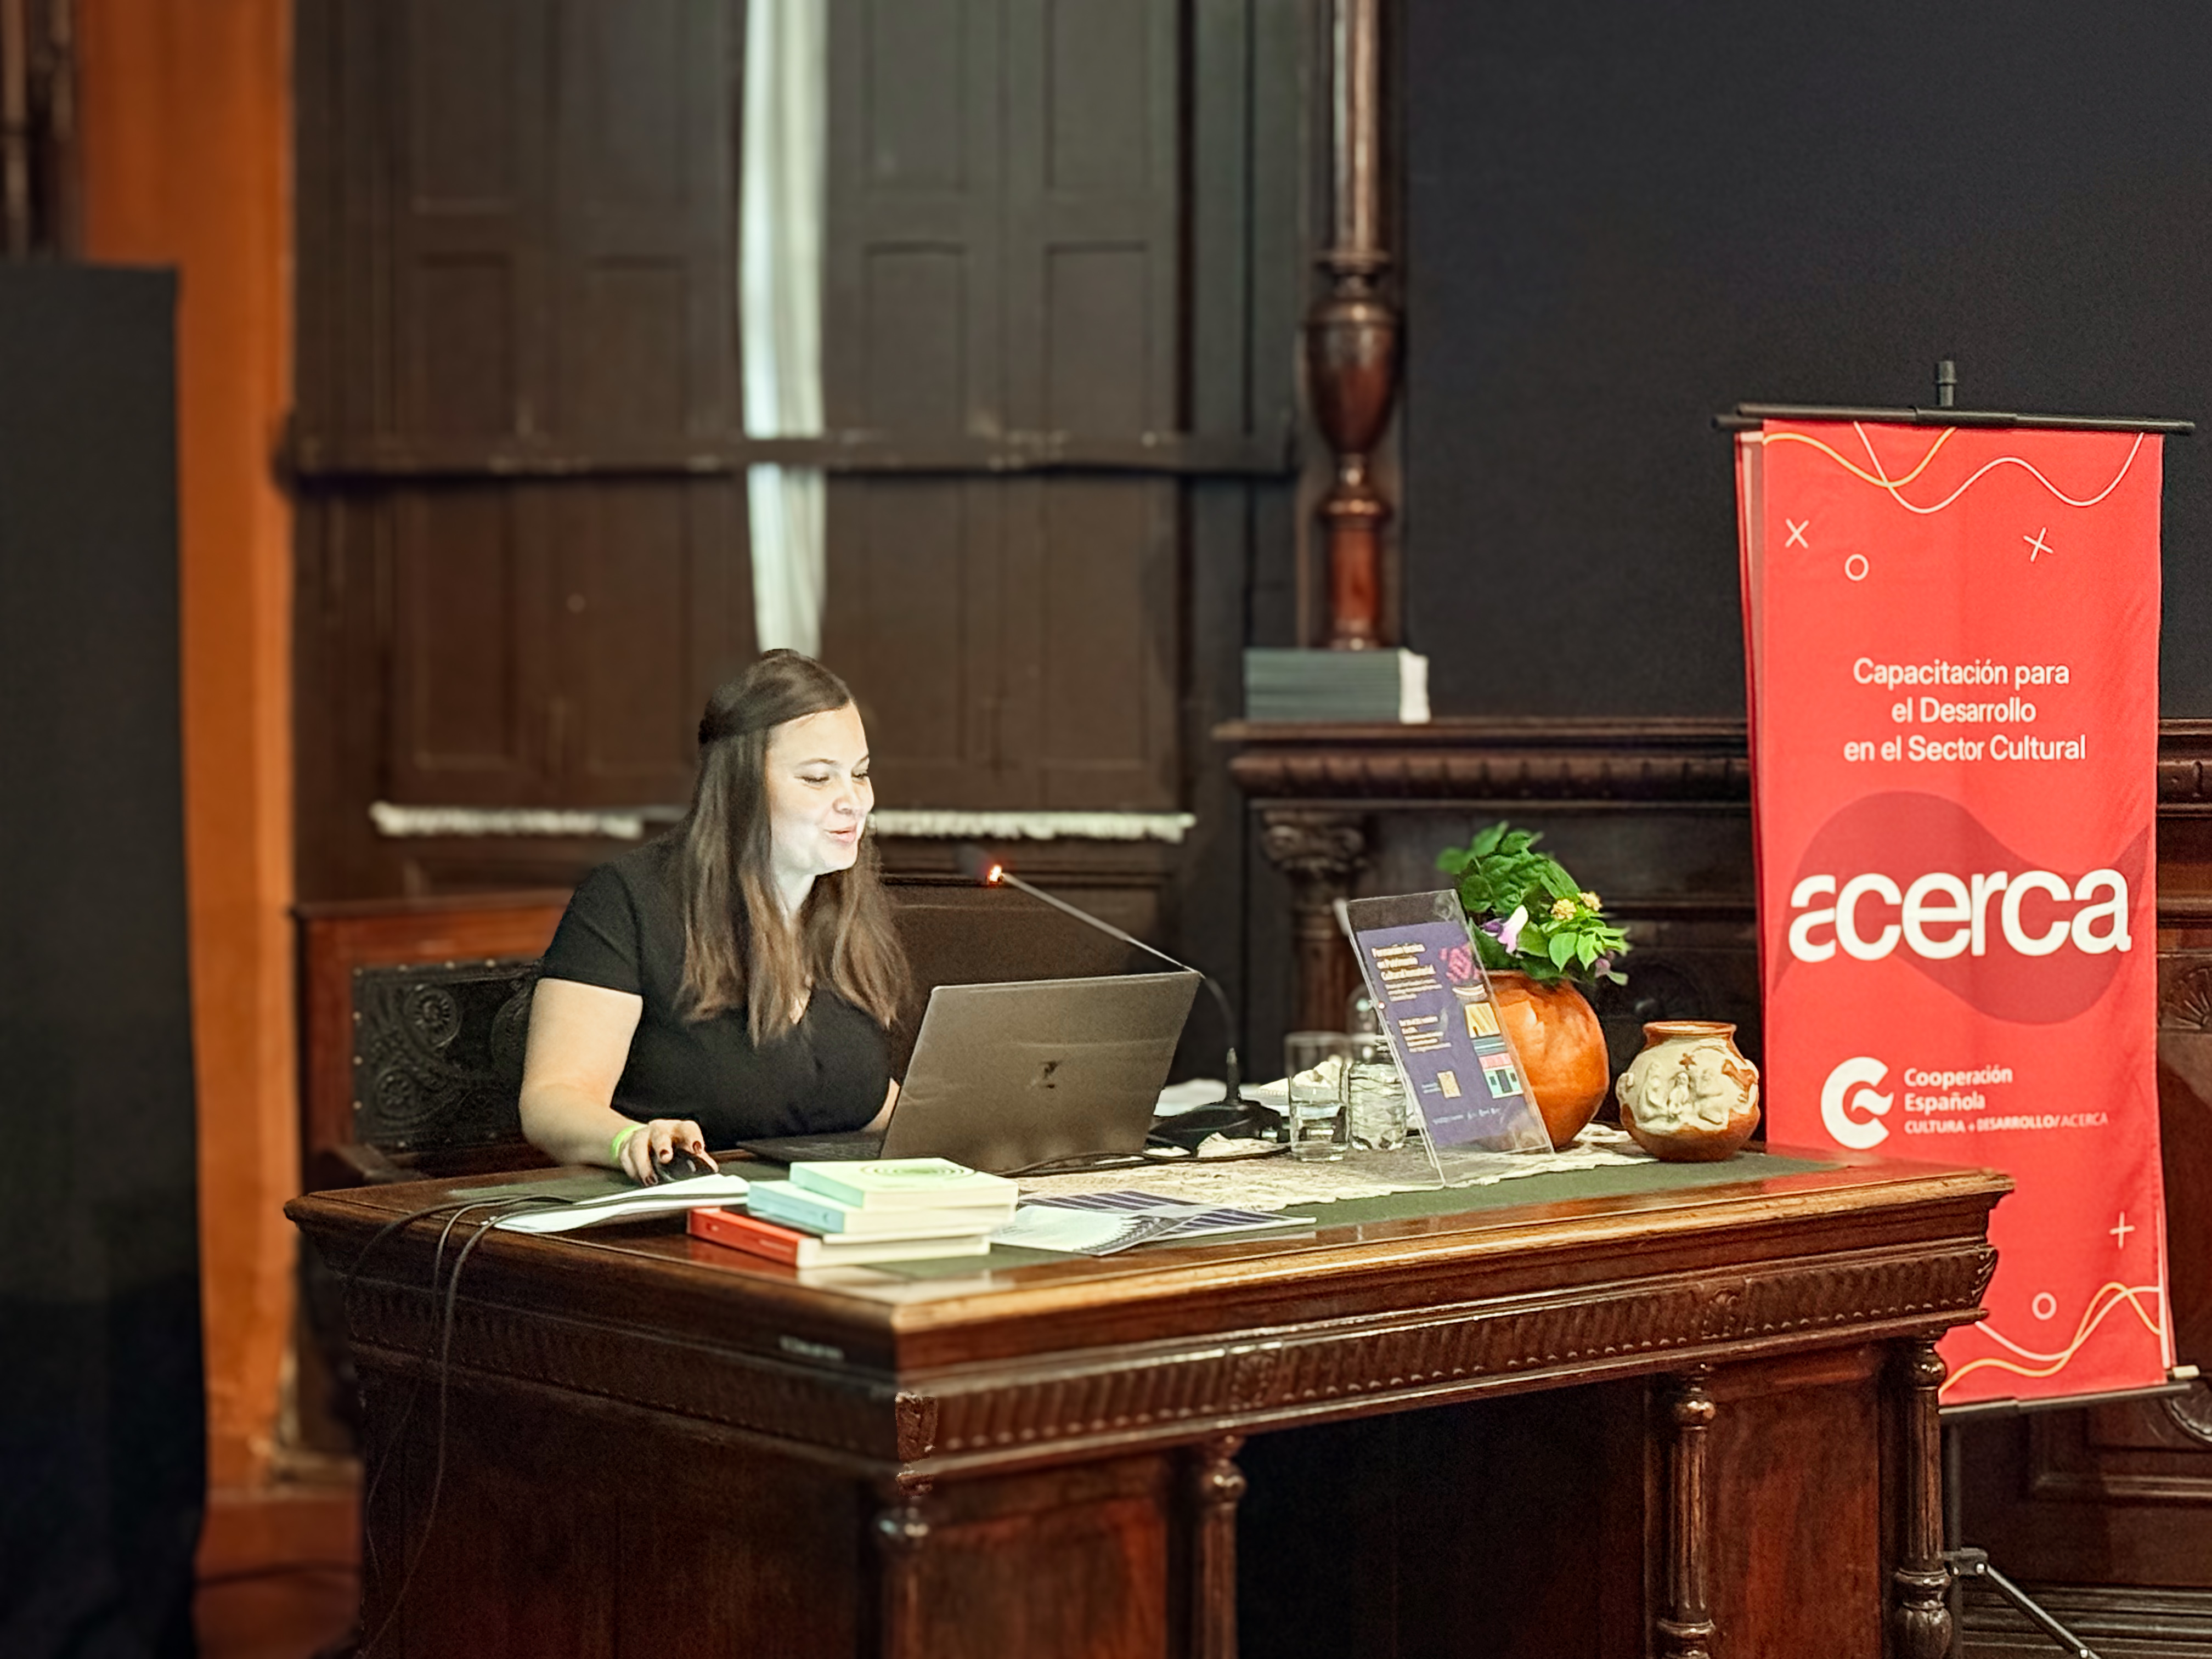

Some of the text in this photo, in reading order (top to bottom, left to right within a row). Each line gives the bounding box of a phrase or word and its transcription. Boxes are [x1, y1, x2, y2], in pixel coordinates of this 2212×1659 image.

[1853, 657, 2069, 691] Capacitación para
[1891, 697, 2036, 723] el Desarrollo
[1844, 735, 2086, 761] en el Sector Cultural
[1788, 868, 2132, 963] acerca
[1904, 1064, 2013, 1091] Cooperación
[1905, 1091, 1985, 1116] Española
[1904, 1120, 1966, 1134] CULTURA
